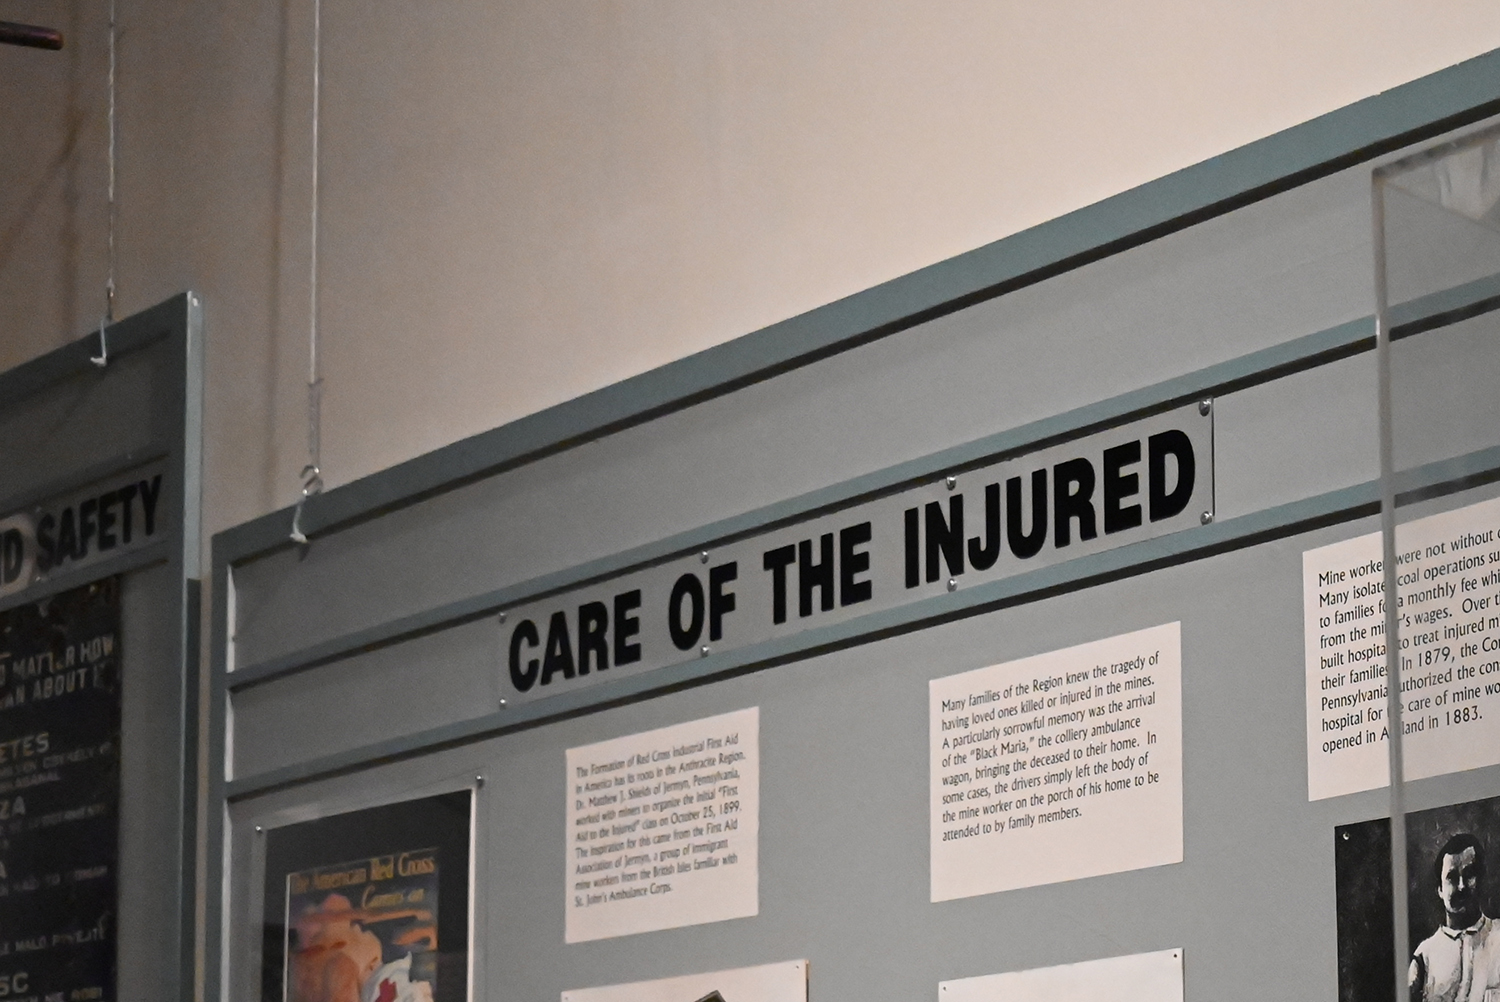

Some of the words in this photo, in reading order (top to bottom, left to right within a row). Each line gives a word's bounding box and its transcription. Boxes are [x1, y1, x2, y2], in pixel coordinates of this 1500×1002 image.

[36, 473, 162, 573] SAFETY
[509, 589, 642, 692] CARE
[668, 562, 738, 651] OF
[763, 521, 872, 625] THE
[904, 429, 1196, 589] INJURED
[1318, 570, 1346, 588] Mine
[1349, 559, 1382, 579] worke
[1395, 549, 1421, 565] were
[1425, 542, 1446, 558] not
[1450, 529, 1494, 551] without
[1318, 590, 1350, 608] Many
[1352, 581, 1384, 600] isolate
[1396, 567, 1420, 586] coal
[1423, 554, 1485, 581] operations
[1319, 616, 1331, 629] to
[1334, 604, 1375, 625] families
[1397, 596, 1403, 607] a
[1407, 581, 1456, 605] monthly
[1460, 576, 1478, 593] fee
[1319, 633, 1346, 649] from
[1349, 626, 1367, 642] the
[1413, 606, 1453, 624] wages.
[1461, 596, 1491, 614] Over
[13, 645, 75, 679] MATTR
[80, 633, 115, 663] HOW
[1320, 651, 1344, 670] built
[1347, 643, 1386, 664] hospita
[1413, 629, 1439, 647] treat
[1443, 616, 1484, 641] injured
[1320, 672, 1346, 691] their
[1349, 663, 1387, 684] families
[1402, 656, 1412, 671] In
[1418, 645, 1455, 667] 1879,
[1460, 642, 1478, 658] the
[33, 667, 88, 700] ABOUT
[941, 698, 966, 713] Many
[968, 689, 1001, 707] families
[1002, 684, 1013, 699] of
[1015, 682, 1030, 696] the
[1032, 675, 1063, 692] Region
[1065, 670, 1090, 685] knew
[1092, 664, 1108, 679] the
[1110, 655, 1146, 675] tragedy
[1148, 650, 1160, 666] of
[1321, 684, 1387, 711] Pennsylvania
[1399, 667, 1452, 693] uthorized
[1456, 664, 1475, 680] the
[941, 737, 950, 750] A
[952, 726, 1001, 750] particularly
[1002, 715, 1045, 737] sorrowful
[1047, 709, 1086, 727] memory
[1087, 705, 1105, 718] was
[1108, 699, 1123, 714] the
[1125, 690, 1156, 710] arrival
[1321, 709, 1363, 732] hospital
[1367, 706, 1383, 722] for
[1407, 697, 1431, 712] care
[1434, 689, 1448, 706] of
[1452, 685, 1481, 703] mine
[1322, 730, 1362, 754] opened
[1365, 729, 1376, 744] in
[1379, 716, 1424, 741] Aland
[1428, 714, 1439, 729] in
[1445, 704, 1483, 726] 1883.
[941, 772, 972, 786] wagon,
[974, 762, 1010, 780] bringing
[1012, 758, 1027, 772] the
[1029, 748, 1070, 769] deceased
[1072, 748, 1083, 760] to
[1085, 741, 1108, 757] their
[1110, 737, 1140, 752] home.
[1147, 730, 1157, 745] In
[942, 822, 980, 842] attended
[982, 823, 992, 834] to
[994, 819, 1005, 833] by
[1008, 813, 1035, 829] family
[1037, 806, 1082, 824] members.
[371, 857, 394, 881] Red
[399, 853, 435, 877] Cross
